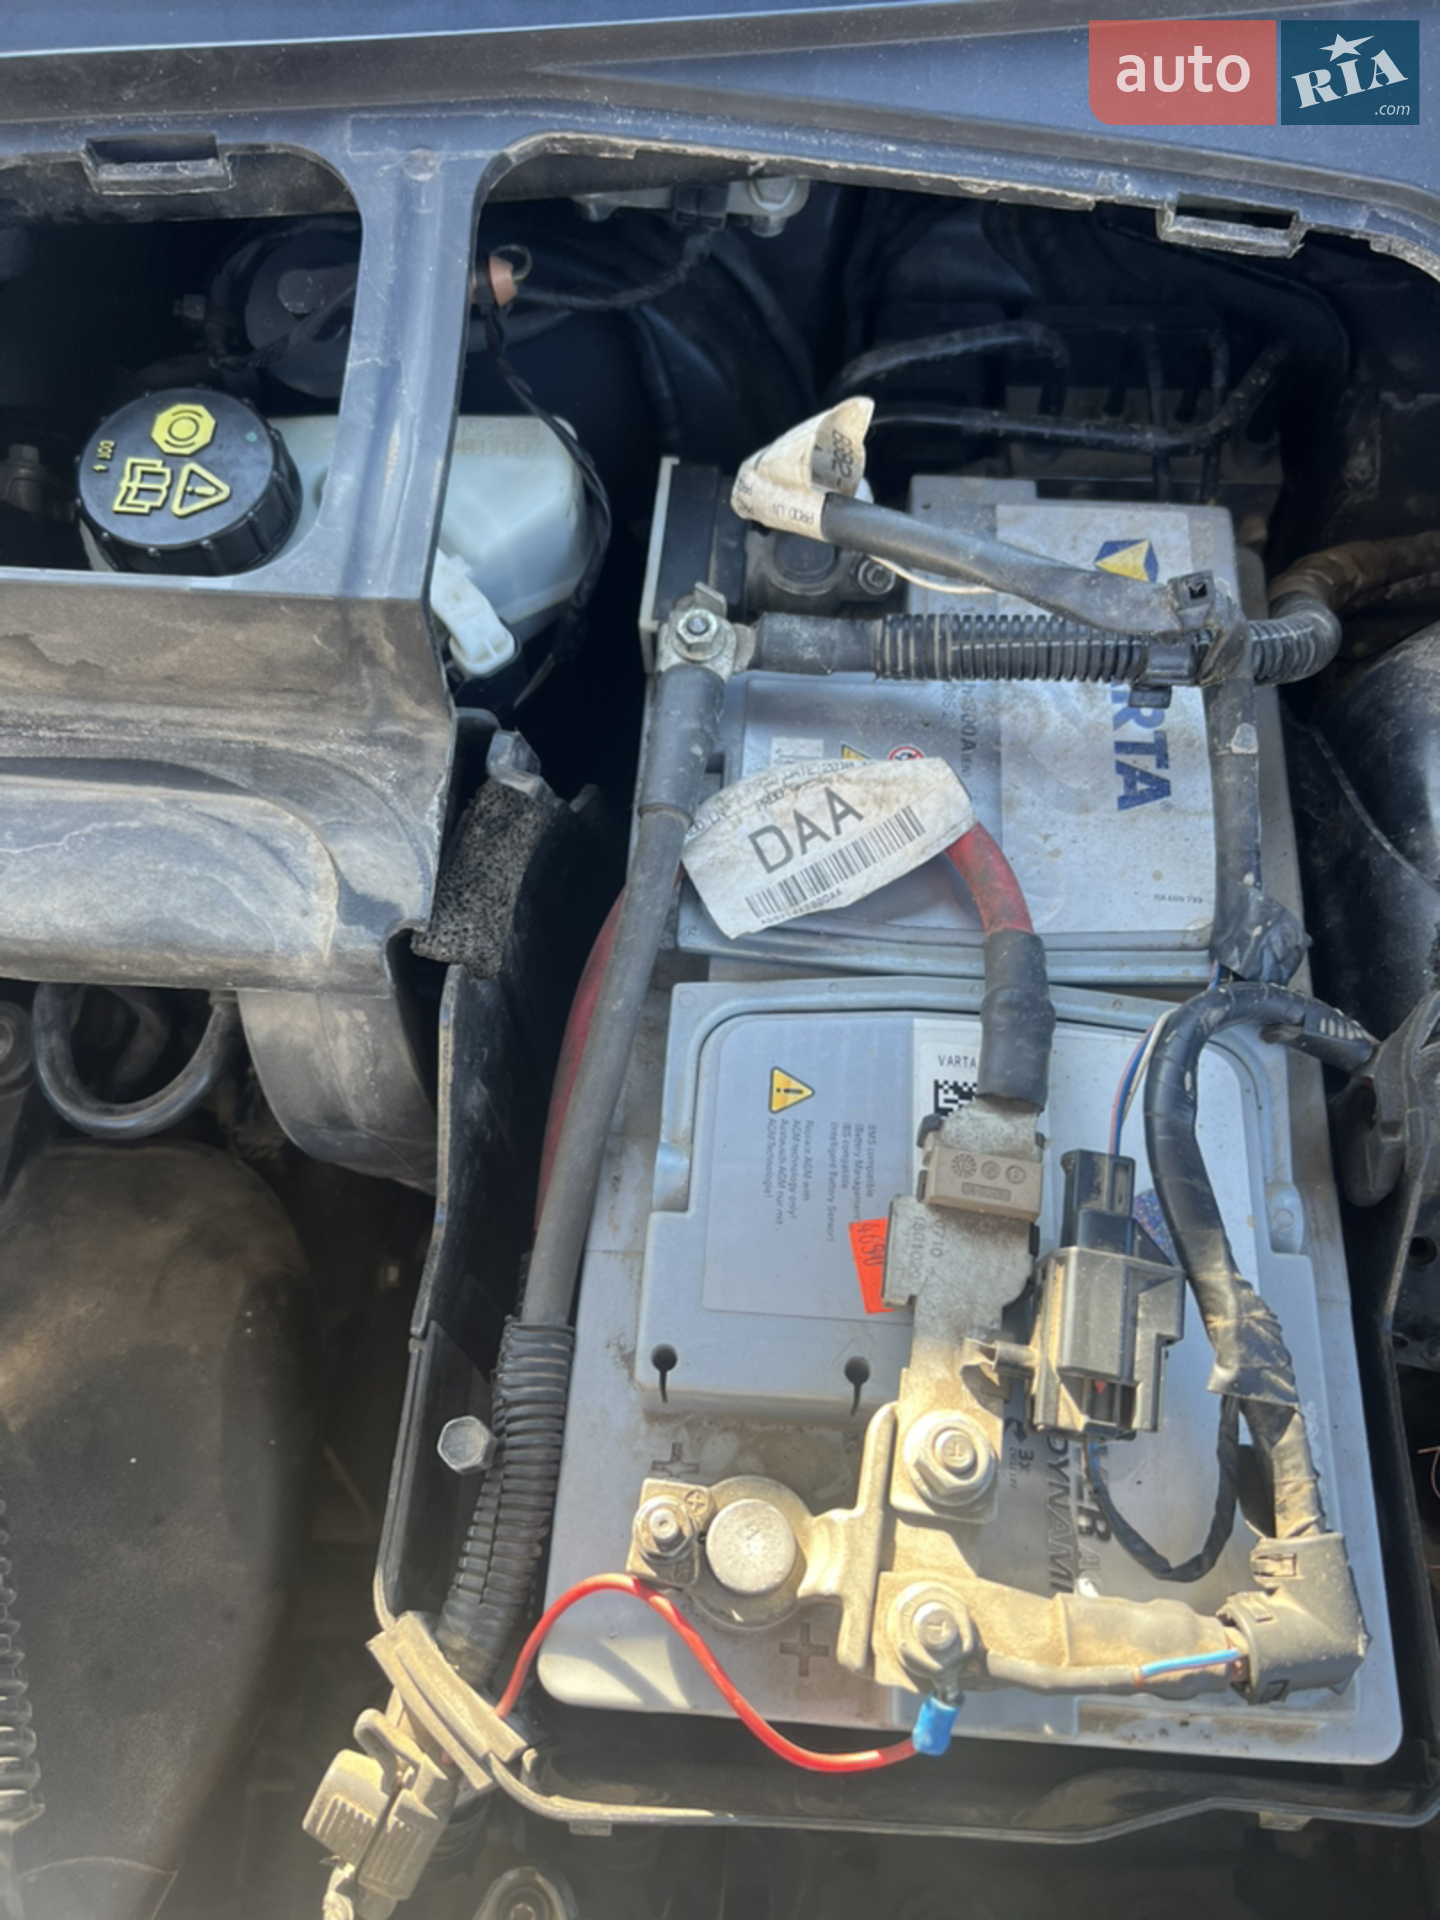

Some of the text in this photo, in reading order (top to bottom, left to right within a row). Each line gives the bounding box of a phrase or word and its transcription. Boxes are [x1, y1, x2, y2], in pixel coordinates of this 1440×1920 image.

[97, 441, 114, 459] DOT
[748, 787, 864, 874] DAA
[937, 1054, 977, 1069] VARTA
[791, 1119, 802, 1143] AGM
[776, 1165, 787, 1189] AGM
[787, 1143, 800, 1193] technology
[801, 1119, 815, 1202] Replace AGM with
[825, 1170, 838, 1203] Battery
[825, 1205, 837, 1242] Sensor)
[1017, 1448, 1035, 1472] 3x
[1047, 1436, 1074, 1594] DYNAMI
